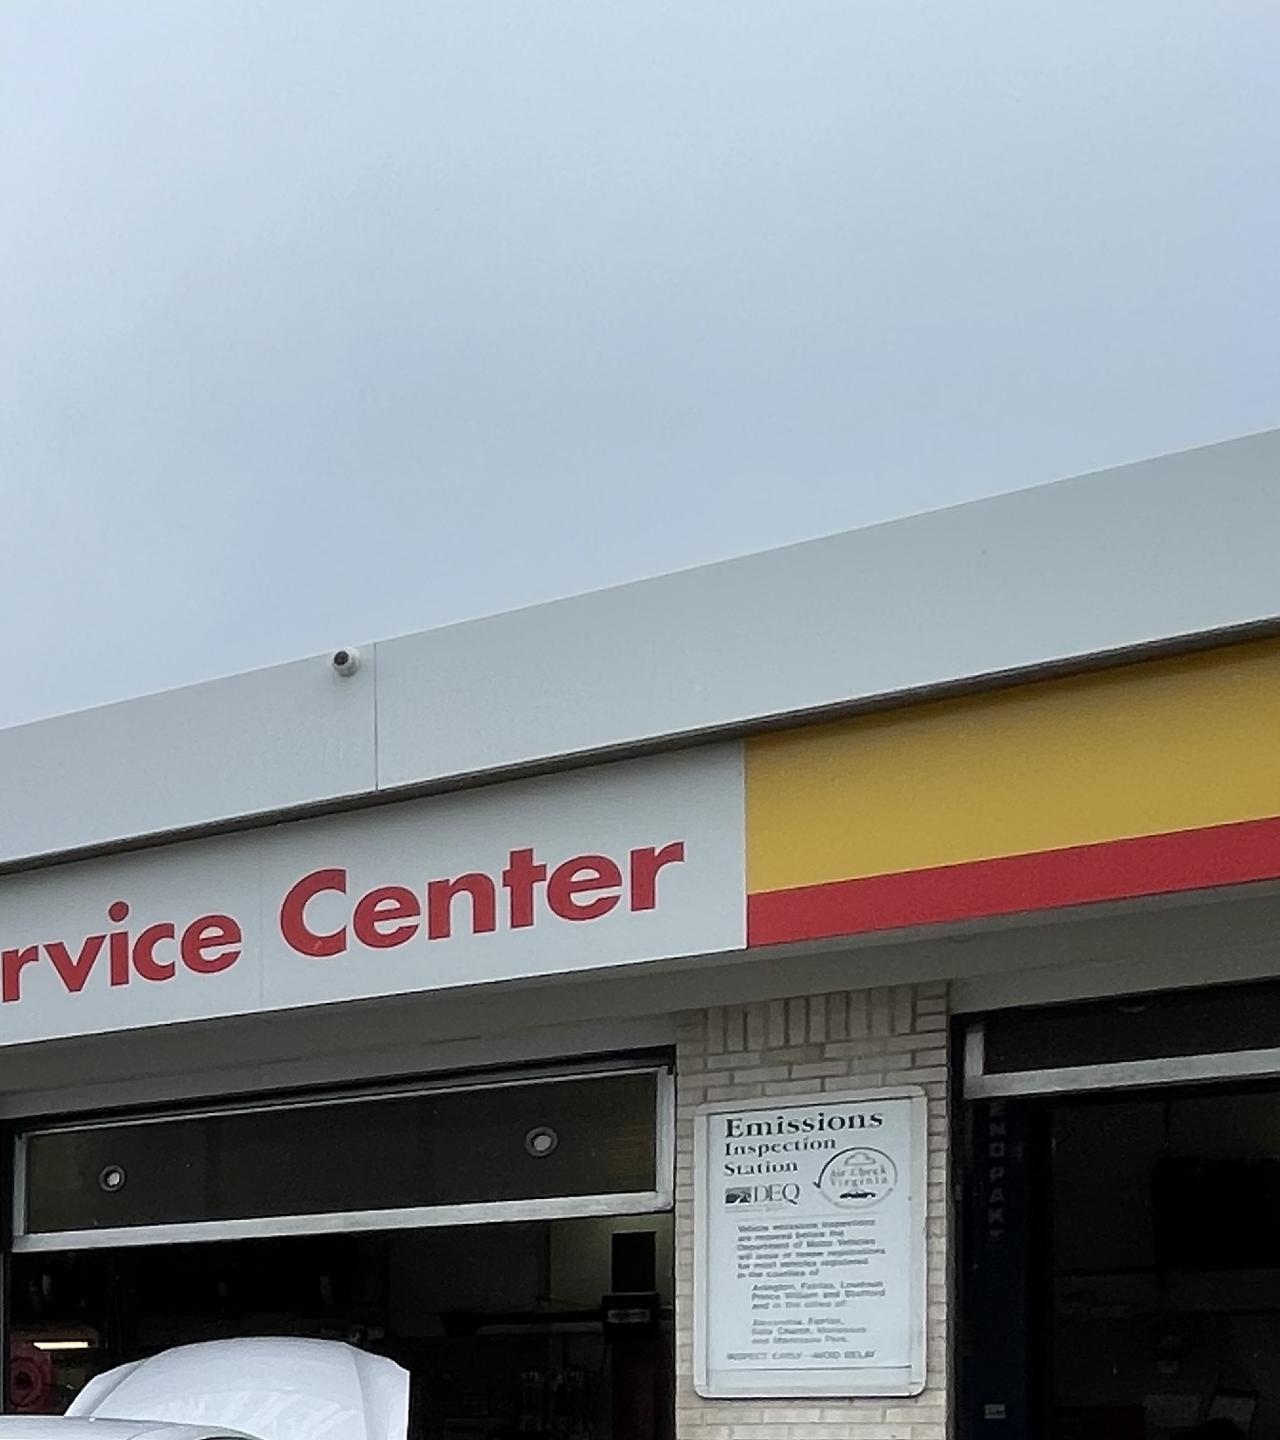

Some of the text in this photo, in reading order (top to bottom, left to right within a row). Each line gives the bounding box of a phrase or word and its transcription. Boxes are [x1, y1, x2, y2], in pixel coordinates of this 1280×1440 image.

[278, 840, 686, 958] Center
[724, 1112, 884, 1139] Emissions
[724, 1136, 837, 1158] Inspection
[723, 1160, 799, 1177] Station
[753, 1182, 801, 1206] DEQ
